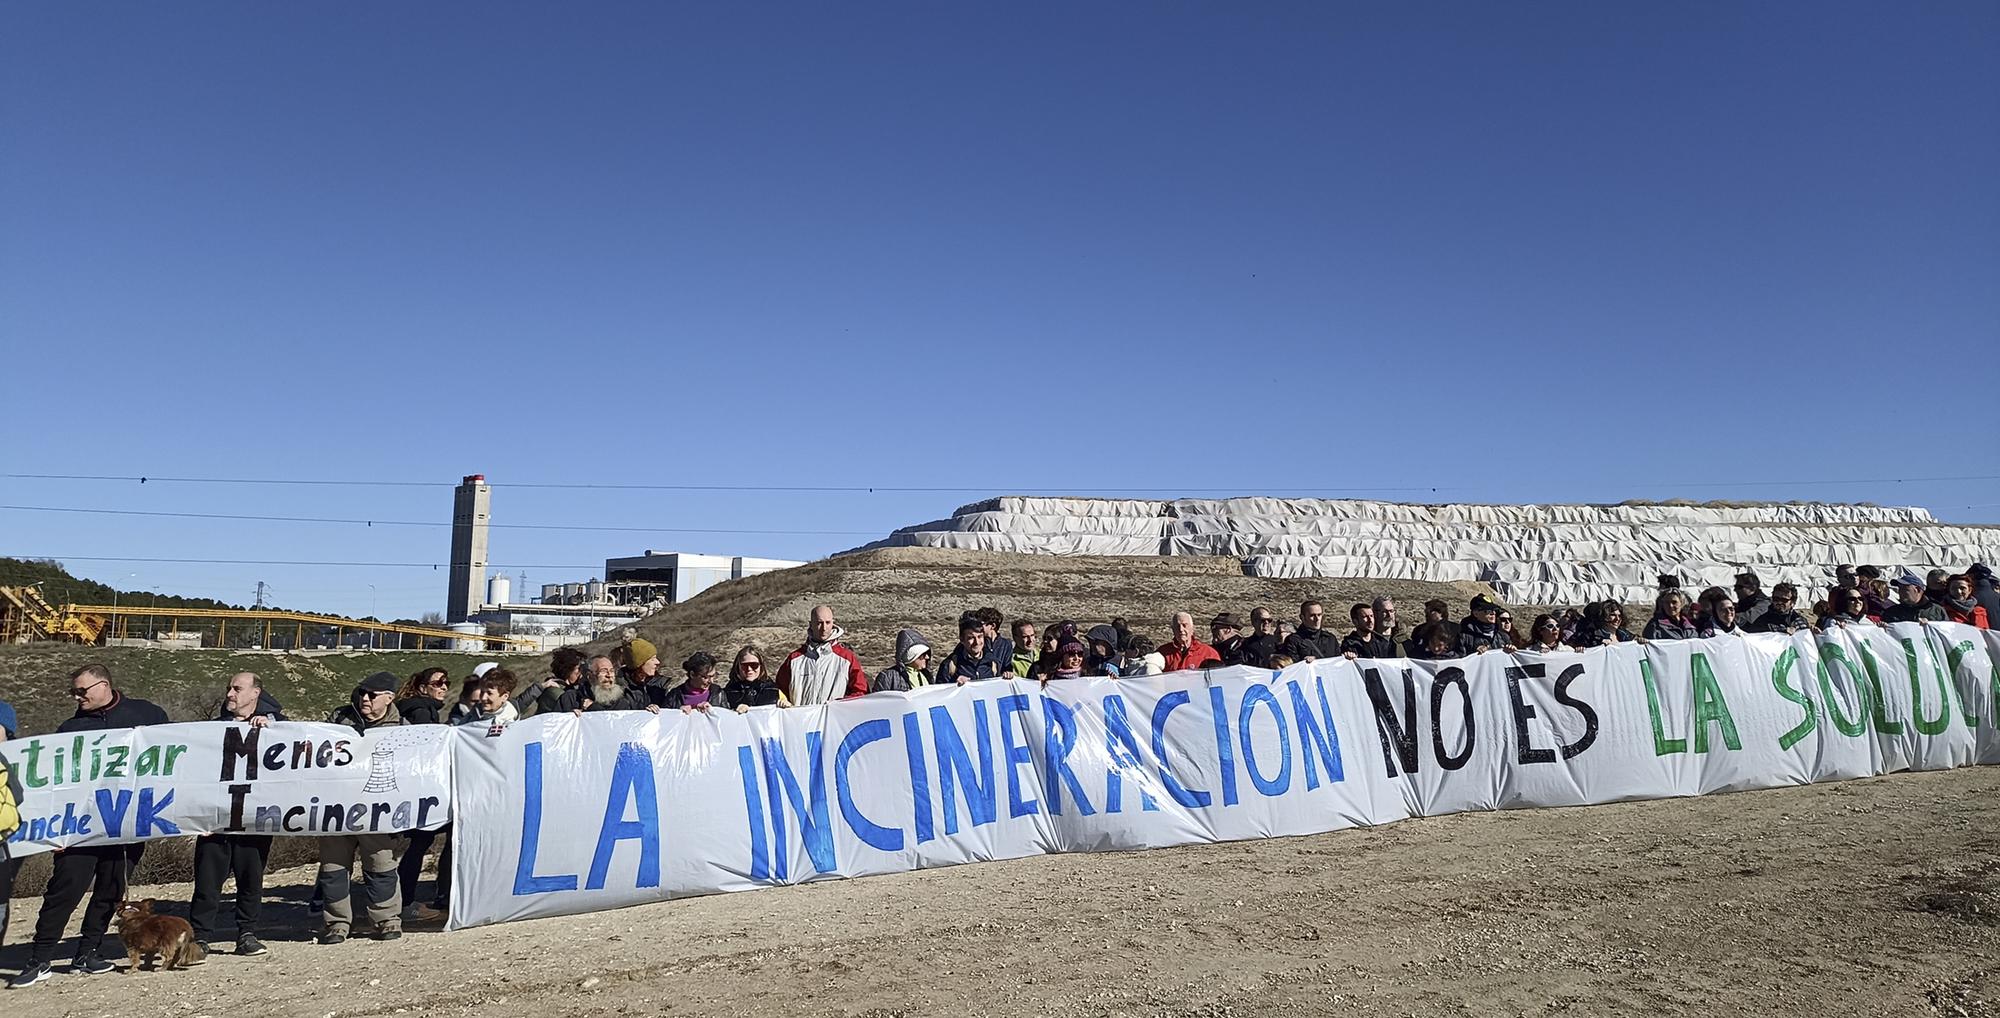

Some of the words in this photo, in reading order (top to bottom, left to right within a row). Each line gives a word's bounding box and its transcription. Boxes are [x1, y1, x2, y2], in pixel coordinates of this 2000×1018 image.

[10, 734, 187, 788] tilízar
[220, 726, 353, 782] Menos
[512, 741, 660, 895] LA
[738, 671, 1344, 881] INCINERACIÓN
[1364, 666, 1476, 778] NO
[1504, 663, 1599, 765] ES
[1640, 652, 1742, 756] LA
[95, 787, 181, 838] VK
[224, 784, 440, 833] Incinerar
